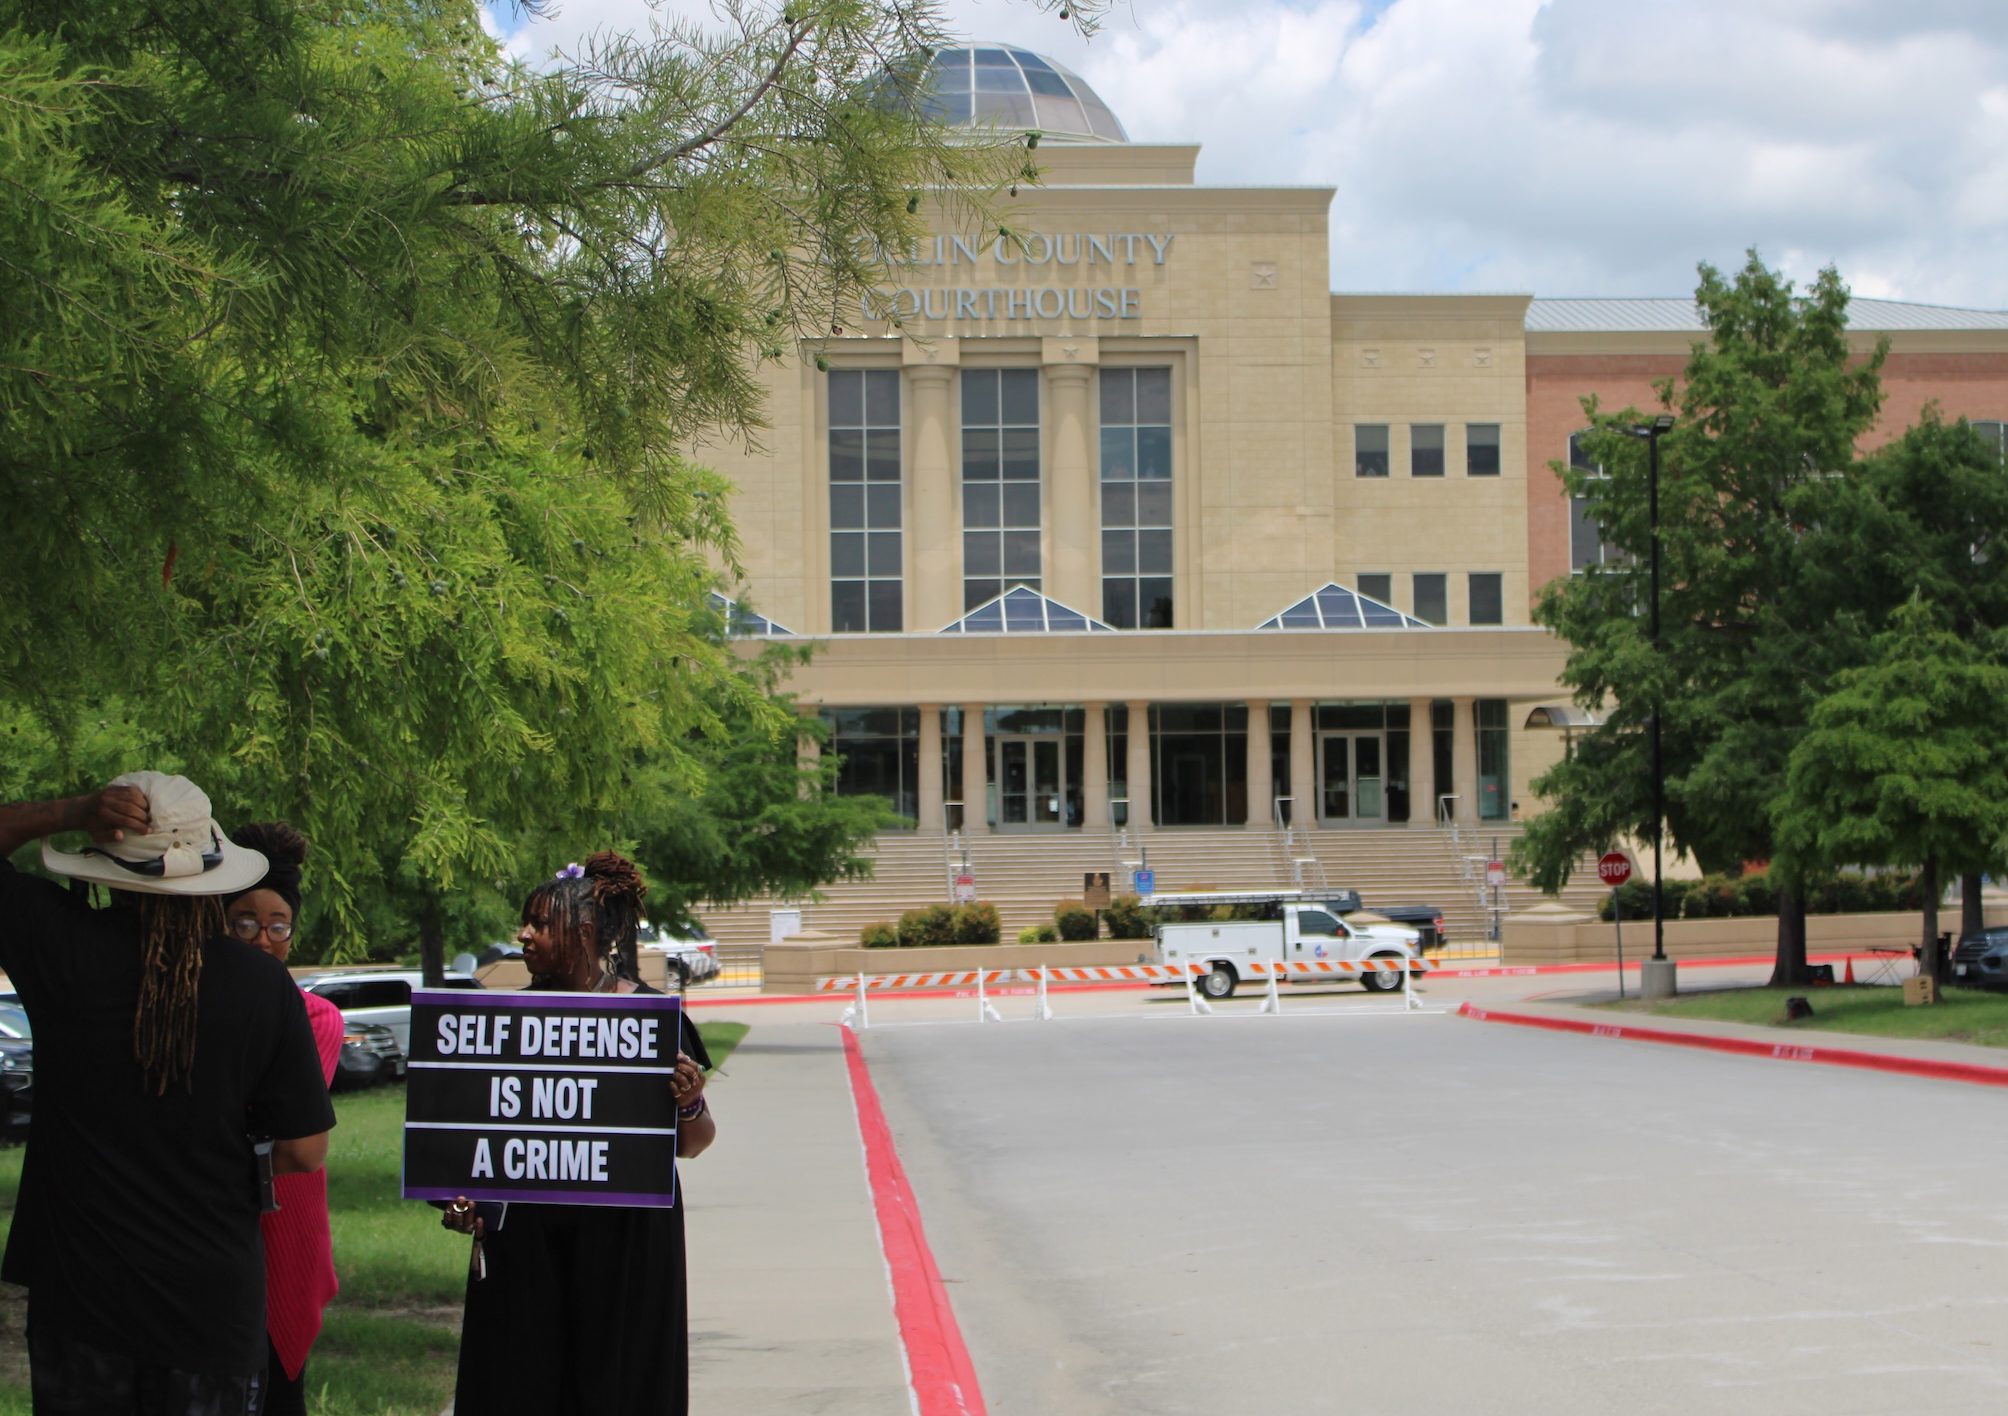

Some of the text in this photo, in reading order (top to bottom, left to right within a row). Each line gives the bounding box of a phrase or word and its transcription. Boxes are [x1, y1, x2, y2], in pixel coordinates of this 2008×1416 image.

[994, 232, 1174, 265] COUNTY
[862, 287, 1142, 320] COURTHOUSE
[1600, 862, 1629, 877] STOP
[437, 1013, 659, 1059] SELF DEFENSE
[490, 1076, 598, 1120] IS NOT
[471, 1138, 609, 1182] A CRIME
